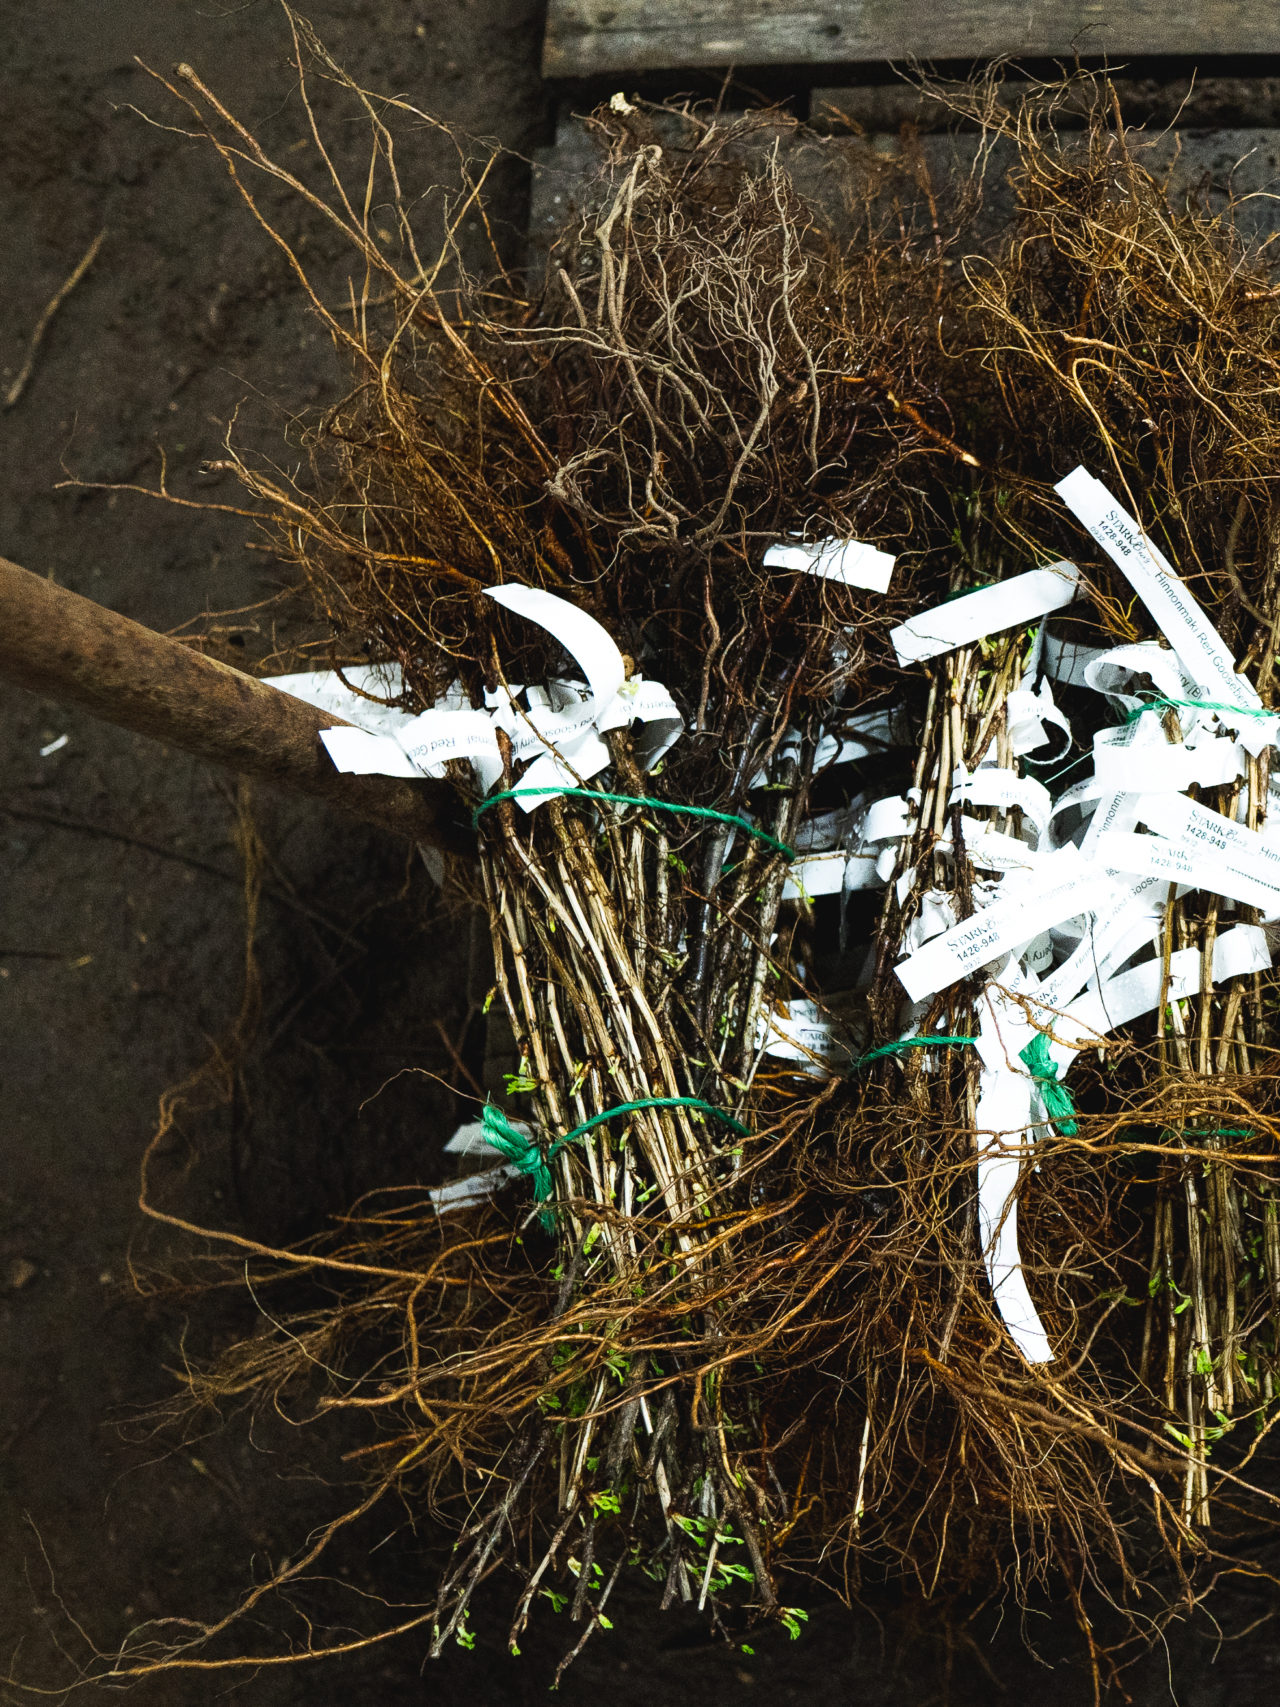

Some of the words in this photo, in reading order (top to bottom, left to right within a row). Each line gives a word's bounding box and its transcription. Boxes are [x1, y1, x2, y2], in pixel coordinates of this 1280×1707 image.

[1098, 520, 1132, 557] 1428-948
[1154, 571, 1199, 634] Hinnonmaki
[1197, 631, 1213, 656] Red
[431, 737, 456, 750] Red
[1186, 823, 1227, 850] 1428-948
[956, 931, 1000, 963] 1428-948
